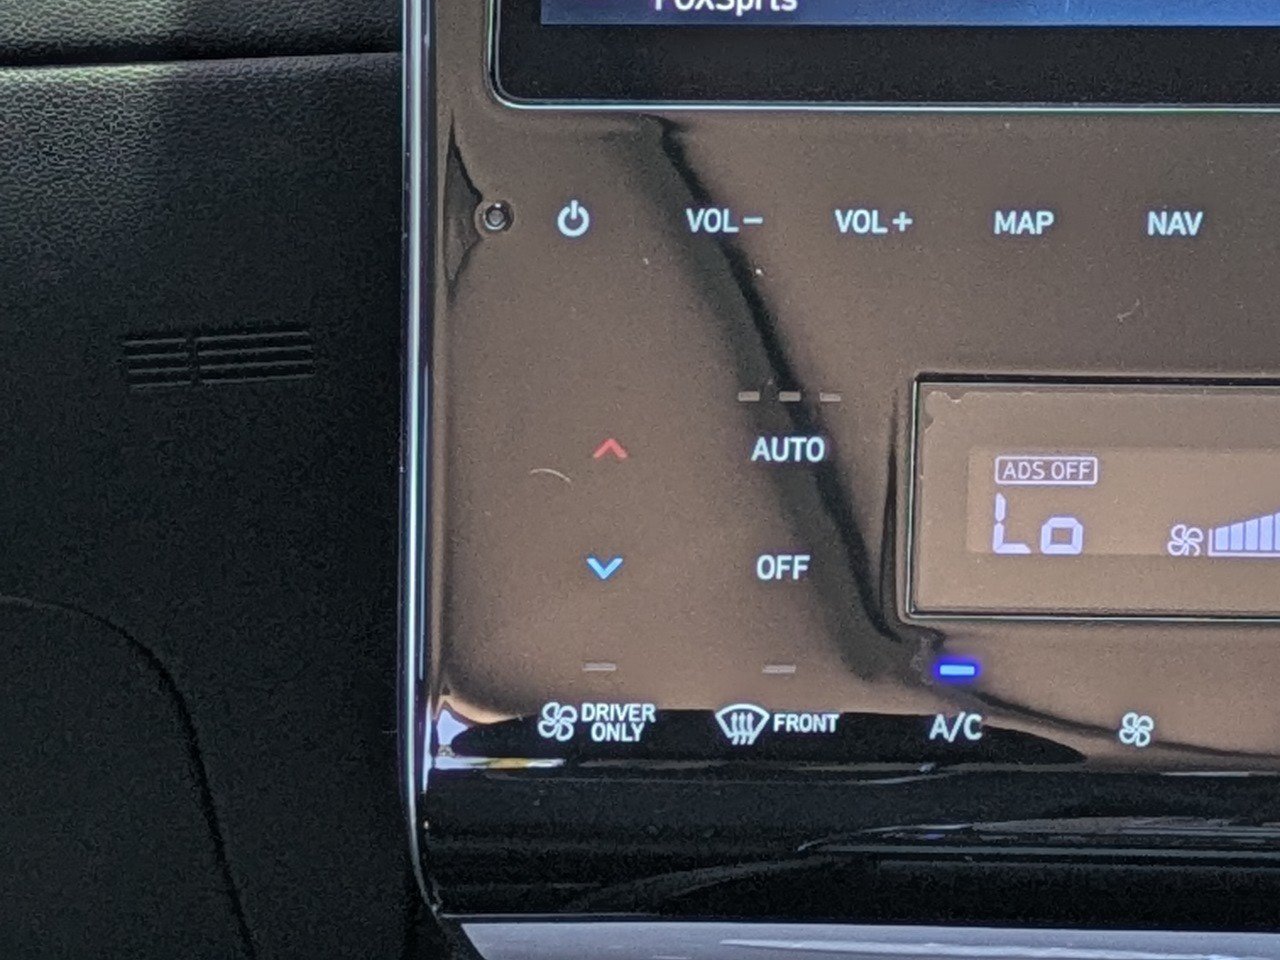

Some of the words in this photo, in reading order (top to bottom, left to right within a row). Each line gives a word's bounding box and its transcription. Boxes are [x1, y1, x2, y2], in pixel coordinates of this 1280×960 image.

[994, 210, 1055, 236] MAP
[1147, 210, 1203, 236] NAV
[751, 437, 826, 462] AUTO
[1003, 462, 1046, 481] ADS
[1051, 462, 1091, 480] OFF
[993, 493, 1084, 556] Lo
[756, 555, 811, 580] OFF
[581, 703, 656, 722] DRIVER
[773, 713, 840, 733] FRONT
[591, 722, 645, 742] ONLY
[930, 712, 983, 742] A/C
